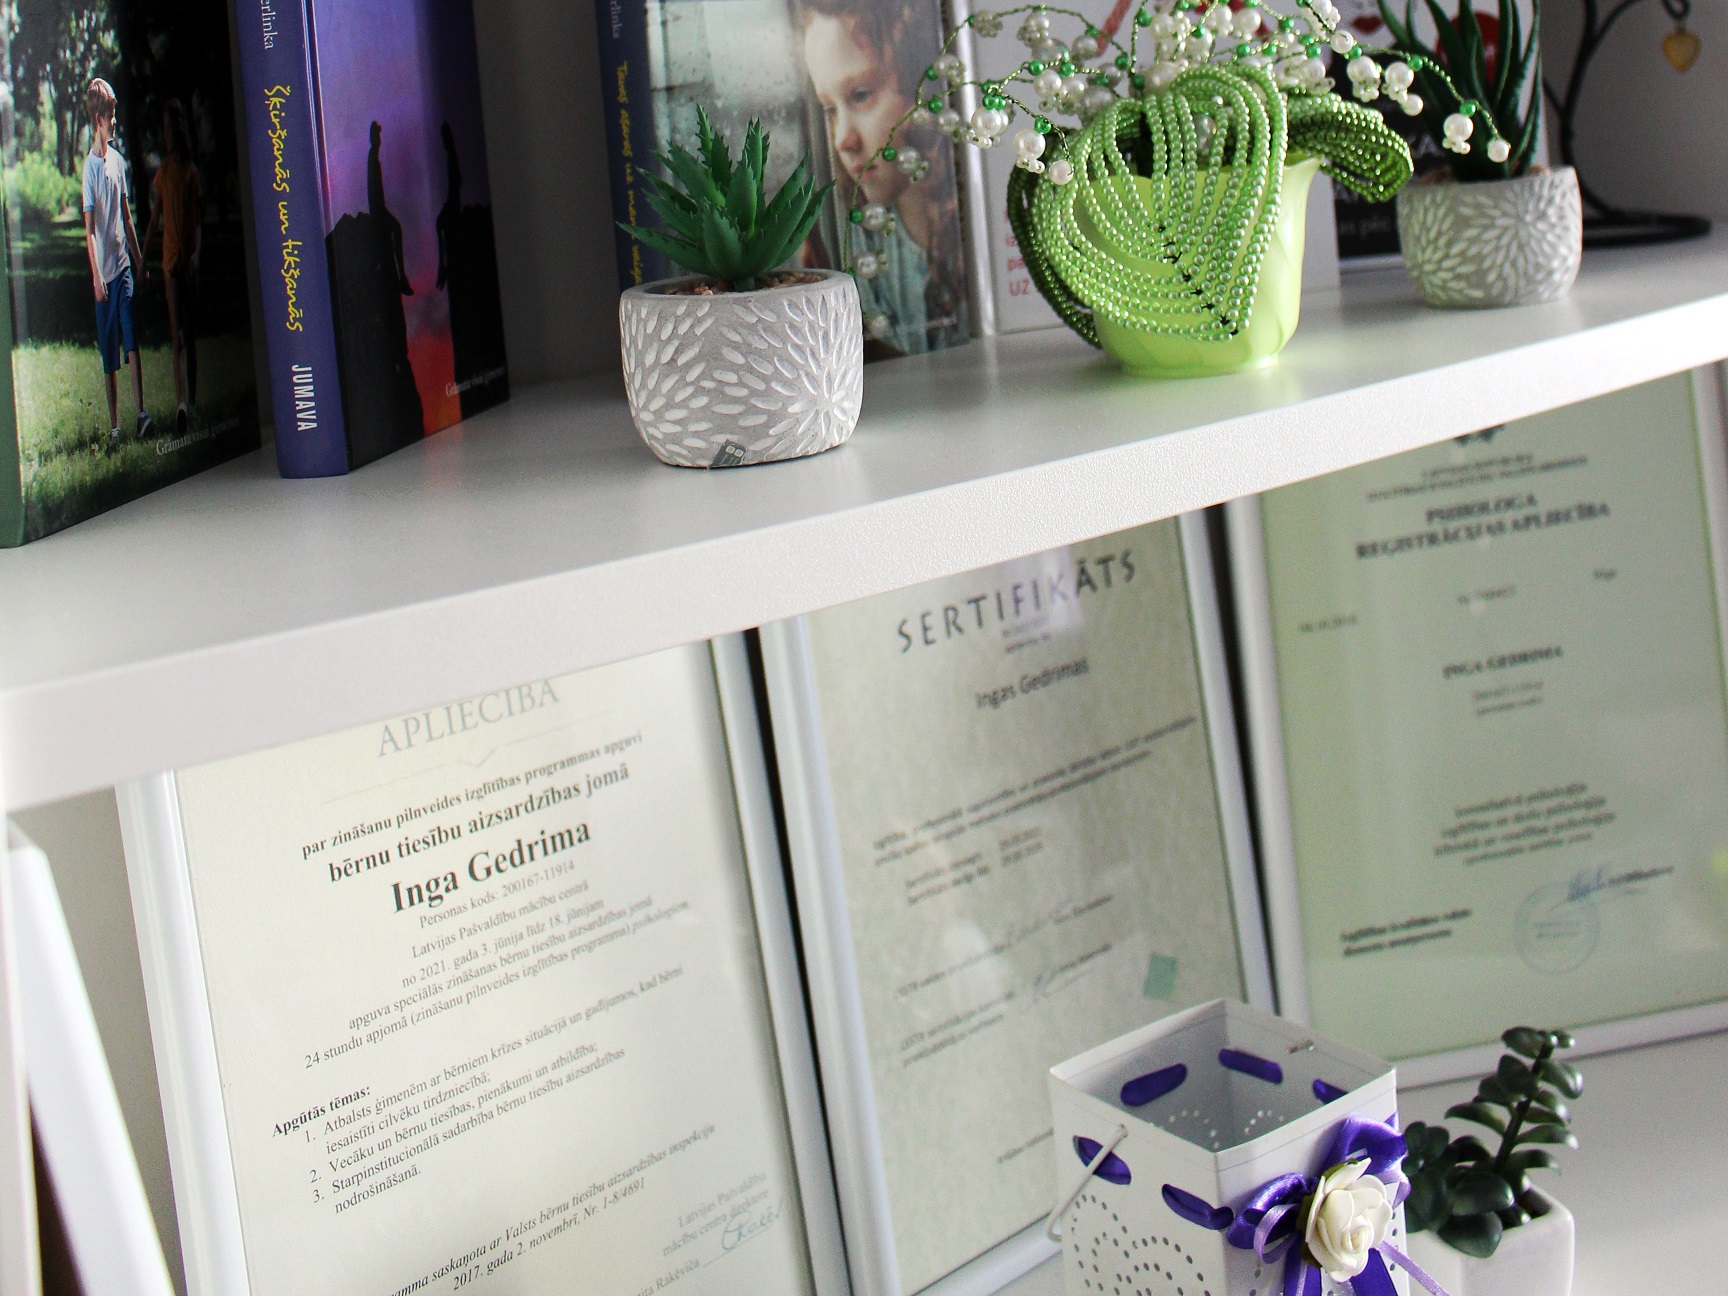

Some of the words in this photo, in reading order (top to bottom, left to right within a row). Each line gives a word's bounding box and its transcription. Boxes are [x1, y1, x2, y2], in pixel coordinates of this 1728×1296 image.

[264, 85, 292, 193] Šķiršanās
[278, 201, 289, 235] un
[282, 239, 303, 333] tikšanās
[291, 364, 318, 432] JUMAVA
[897, 550, 1136, 654] SERTIFIKĀTS
[302, 840, 326, 860] par
[332, 819, 392, 846] zināšanu
[396, 796, 461, 829] pilnveides
[465, 775, 521, 801] izglītības
[524, 748, 601, 785] programmas
[329, 850, 390, 882] bērnu
[397, 825, 461, 858] tiesību
[468, 784, 581, 834] aizsardzības
[586, 763, 629, 798] jomā
[392, 872, 459, 912] Inga
[468, 823, 590, 882] Gedrima
[420, 904, 468, 928] Personas
[470, 891, 497, 909] kods:
[402, 975, 416, 988] no
[420, 960, 450, 981] 2021.
[454, 949, 479, 970] gada
[482, 943, 491, 956] 3.
[526, 922, 545, 937] līdz
[412, 934, 456, 958] Latvijas
[459, 911, 516, 940] Pašvaldību
[305, 1052, 320, 1068] 24
[324, 1036, 363, 1060] stundu
[366, 1016, 408, 1044] apjomā
[411, 995, 463, 1026] (zināšanu
[466, 972, 520, 1005] pilnveides
[522, 952, 568, 977] izglītības
[349, 1006, 391, 1030] apguva
[393, 984, 443, 1012] speciālās
[447, 962, 497, 989] zināšanas
[499, 949, 529, 967] bērnu
[532, 934, 566, 954] tiesību
[273, 1106, 326, 1136] Apgūtās
[329, 1087, 370, 1111] tēmas:
[305, 1130, 315, 1143] 1.
[325, 1106, 371, 1135] Atbalsts
[375, 1082, 427, 1115] ģimenēm
[430, 1075, 441, 1087] ar
[443, 1054, 488, 1080] bērniem
[490, 1040, 522, 1060] krīzes
[525, 1017, 567, 1044] situācijā
[569, 1012, 582, 1024] un
[310, 1169, 321, 1183] 2.
[329, 1146, 374, 1172] Vecāku
[377, 1138, 392, 1151] un
[395, 1122, 427, 1143] bērnu
[430, 1102, 475, 1126] tiesības,
[477, 1070, 532, 1108] pienākumi
[535, 1066, 548, 1078] un
[327, 1122, 375, 1154] iesaistīti
[379, 1105, 420, 1130] cilvēku
[423, 1072, 490, 1110] tirdzniecībā;
[313, 1189, 324, 1203] 3.
[332, 1134, 439, 1193] Starpinstitucionālā
[442, 1111, 494, 1141] sadarbība
[496, 1096, 527, 1115] bērnu
[529, 1078, 563, 1100] tiesību
[335, 1164, 421, 1213] nodrošināšanā.
[432, 1246, 486, 1281] saskaņota
[490, 1237, 501, 1250] ar
[506, 1219, 536, 1241] Valsts
[540, 1202, 569, 1224] bērnu
[572, 1183, 605, 1206] tiesību
[454, 1265, 483, 1291] 2017.
[487, 1250, 513, 1275] gada
[517, 1242, 526, 1256] 2.
[530, 1213, 580, 1249] novembrī,
[584, 1205, 598, 1220] Nr.
